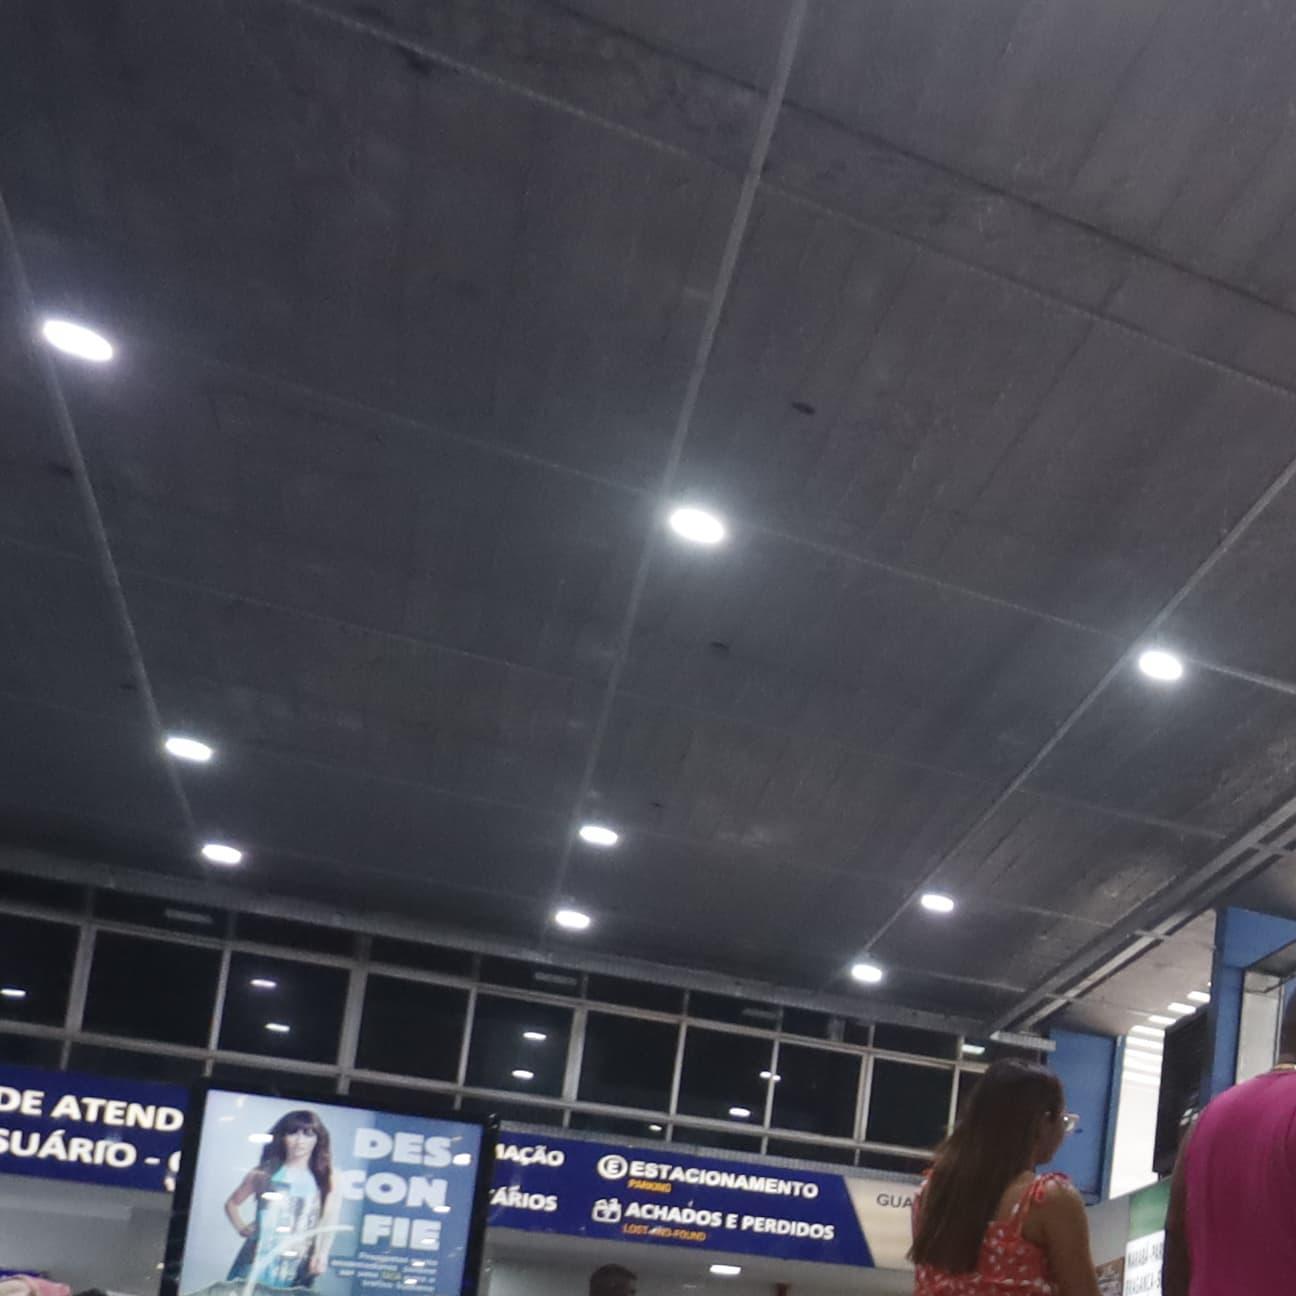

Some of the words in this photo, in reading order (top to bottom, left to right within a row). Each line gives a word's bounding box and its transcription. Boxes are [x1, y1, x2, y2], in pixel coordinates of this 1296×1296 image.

[0, 1086, 45, 1116] DE
[51, 1094, 184, 1132] ATEND
[341, 1169, 449, 1208] CON
[489, 1185, 558, 1212] ÁRIOS
[629, 1160, 819, 1199] ESTACIONAMENTO
[361, 1214, 442, 1251] FIE
[625, 1202, 722, 1229] ACHADOS
[726, 1213, 738, 1228] E
[741, 1215, 835, 1241] PERDIDOS
